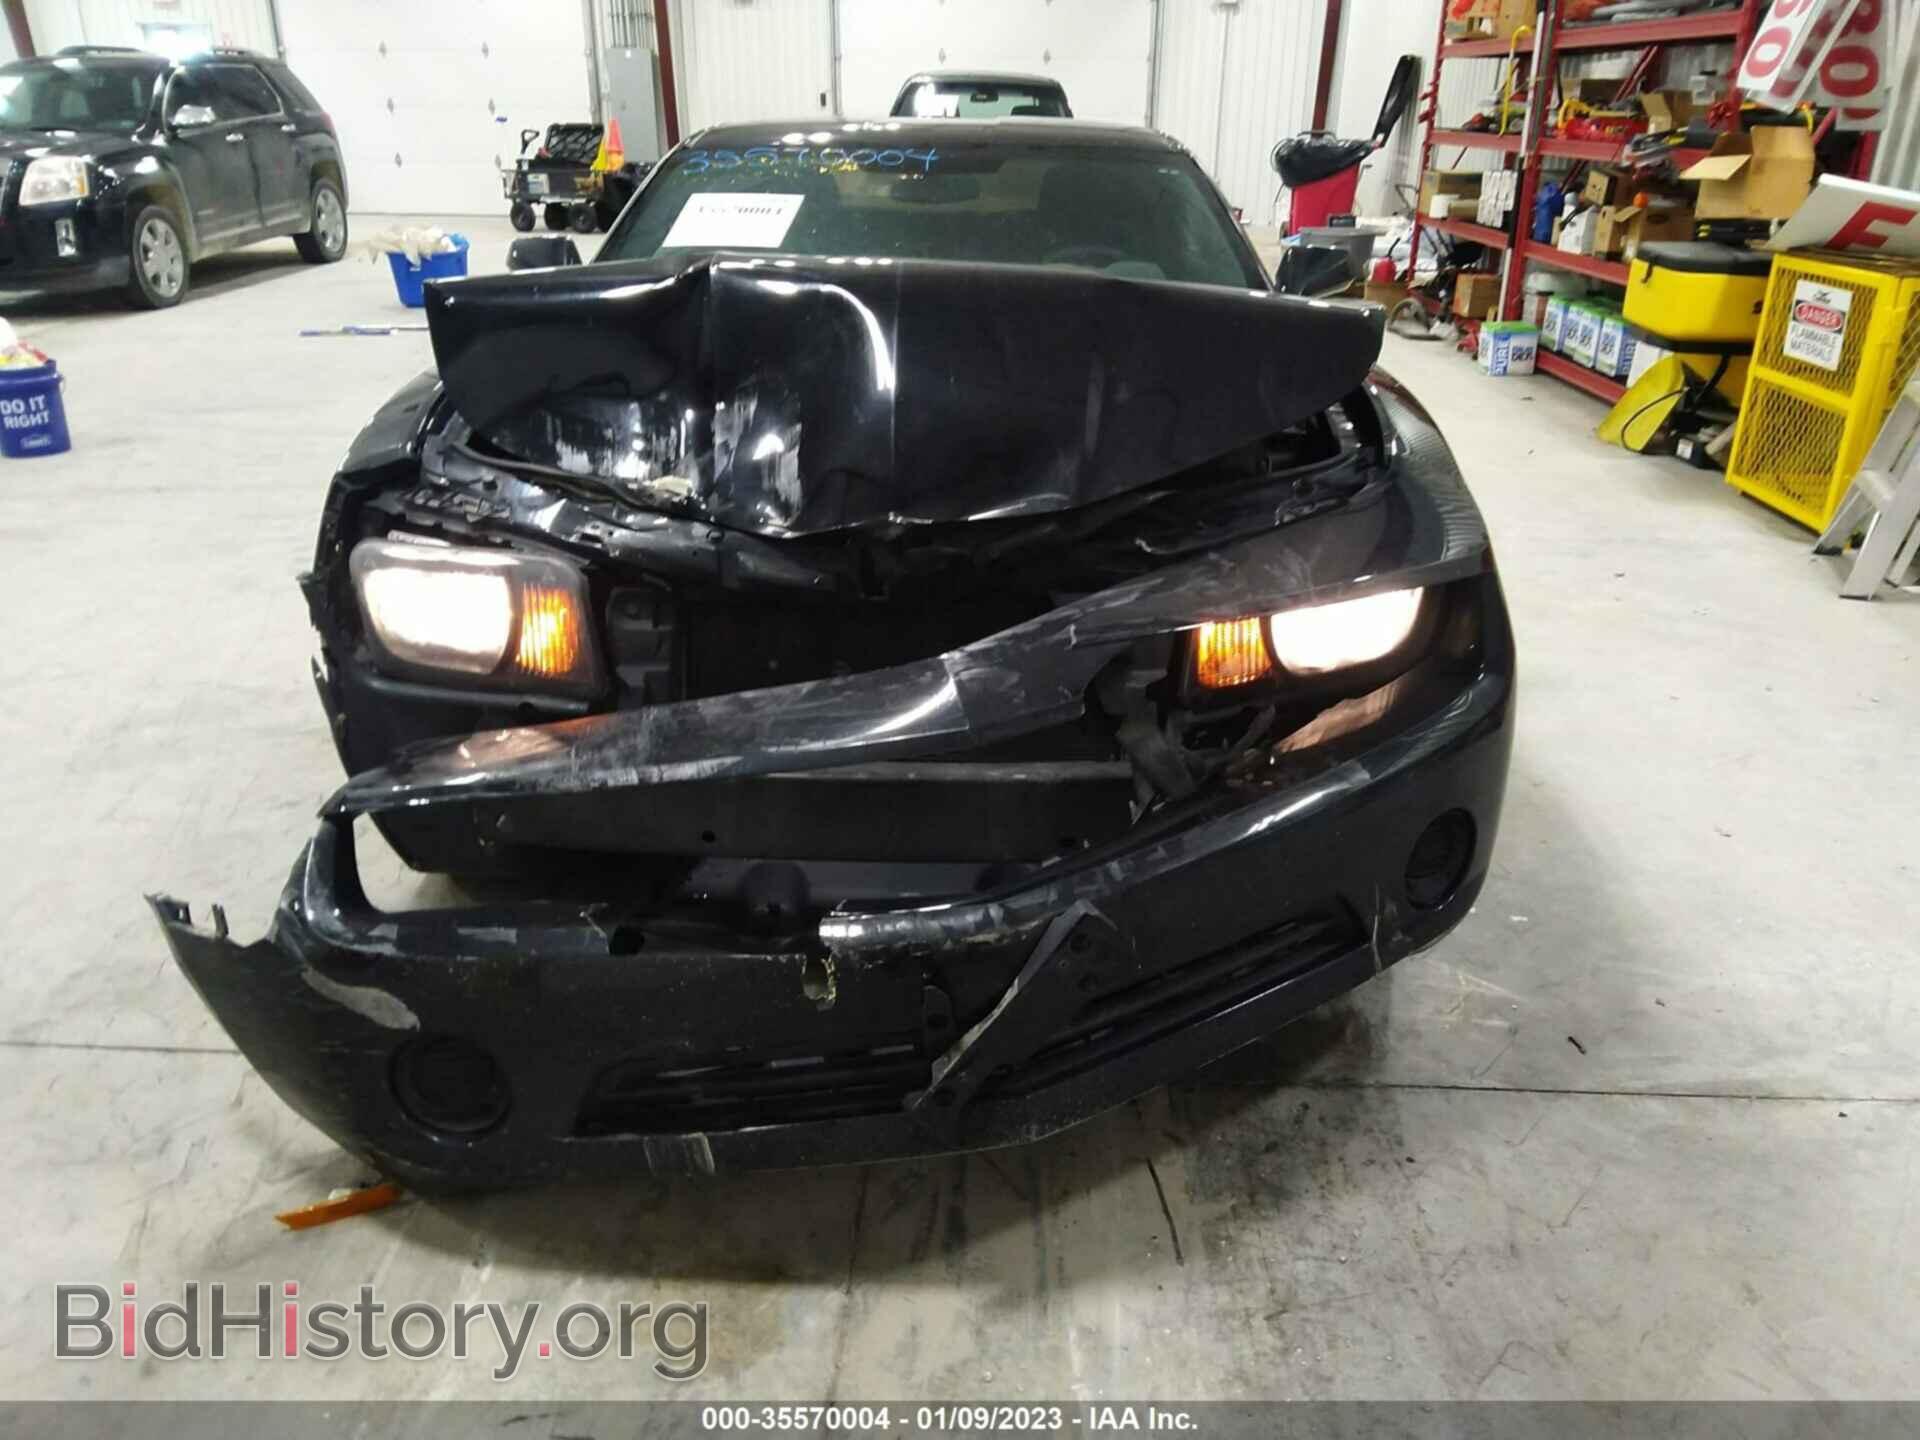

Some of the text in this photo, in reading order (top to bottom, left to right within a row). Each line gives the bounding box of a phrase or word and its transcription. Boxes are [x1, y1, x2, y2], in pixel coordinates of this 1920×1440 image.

[0, 394, 46, 415] DO IT
[3, 410, 50, 430] RIGHT
